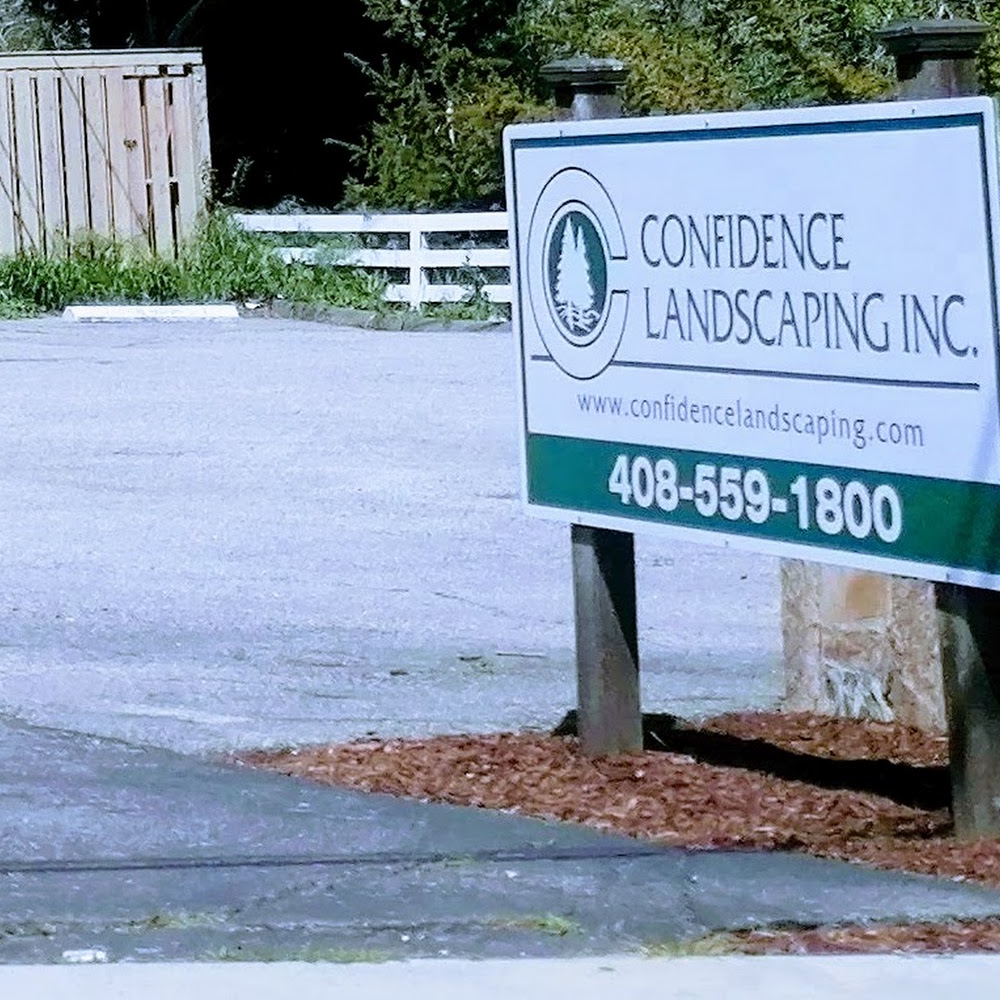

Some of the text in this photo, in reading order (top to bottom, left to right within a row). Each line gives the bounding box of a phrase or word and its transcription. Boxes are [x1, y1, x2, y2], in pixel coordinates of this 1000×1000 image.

[641, 212, 851, 271] CONFIDENCE
[643, 286, 977, 358] LANDSCAPING INC.
[578, 391, 925, 449] www.confidencelandscaping.com
[608, 455, 902, 544] 408-559-1800
